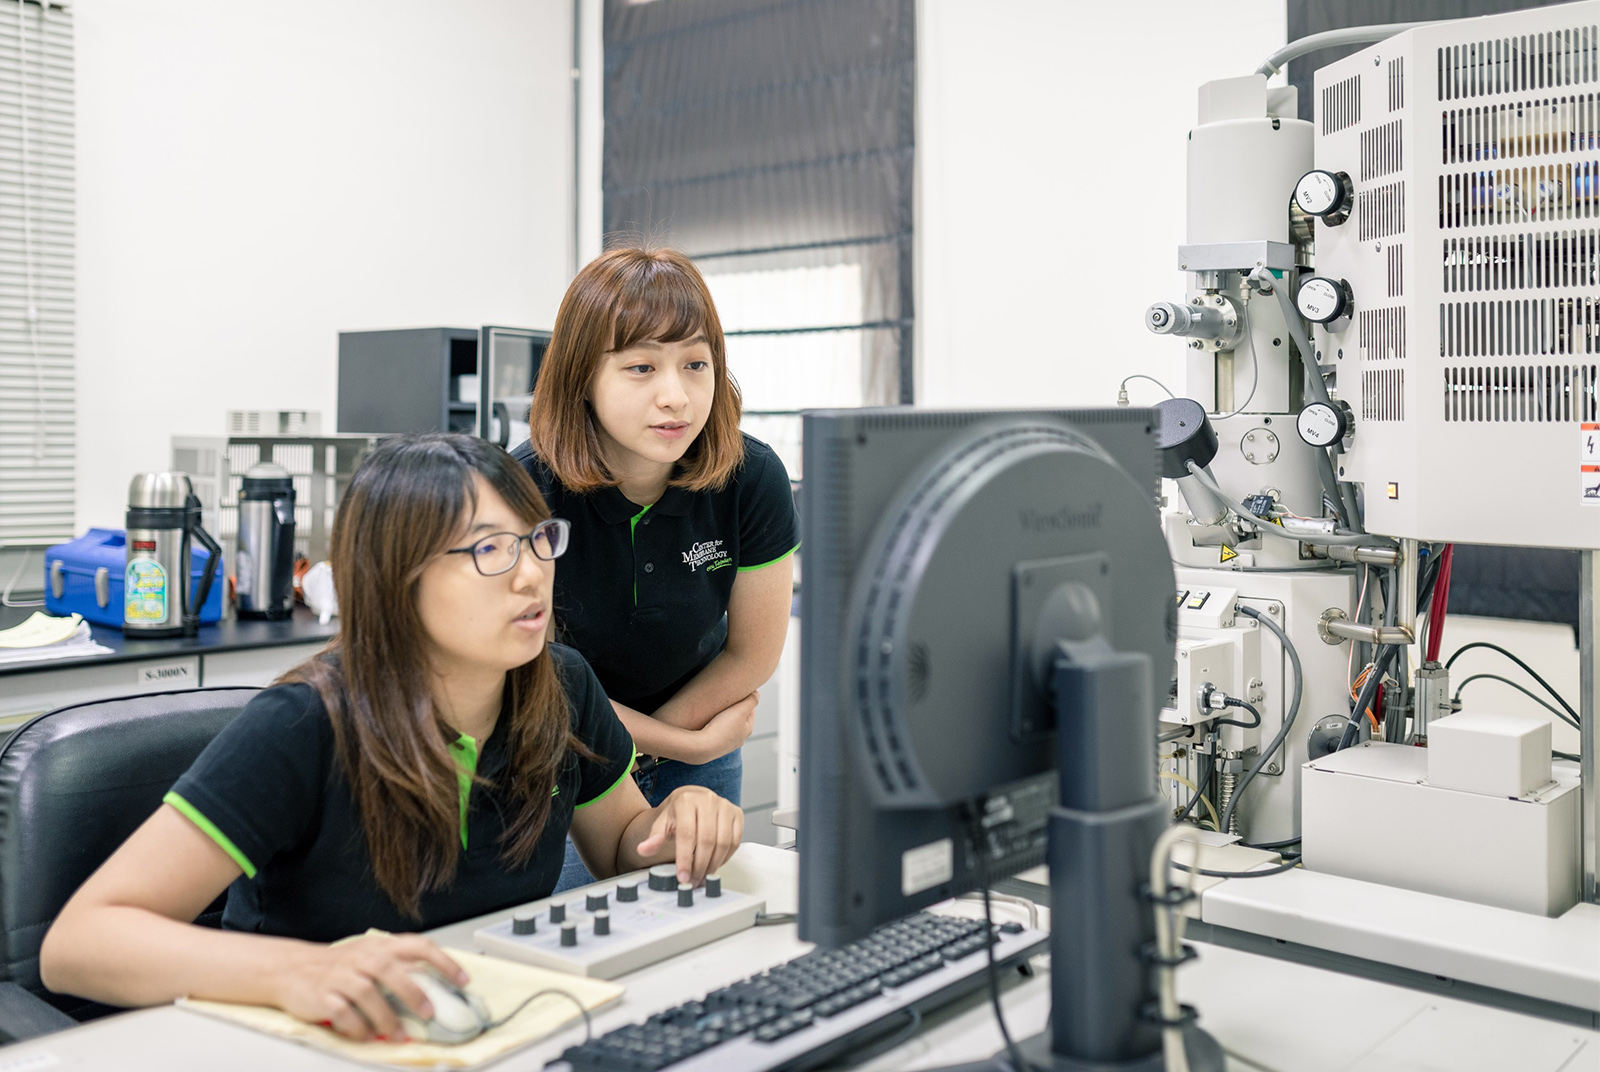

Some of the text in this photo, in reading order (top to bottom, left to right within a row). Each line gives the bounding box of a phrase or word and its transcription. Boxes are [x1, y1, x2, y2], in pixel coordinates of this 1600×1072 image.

[1302, 190, 1313, 204] MV2
[1323, 291, 1335, 300] CLOSE
[1306, 303, 1320, 314] MV3
[1307, 408, 1318, 416] OPEN
[1323, 417, 1336, 426] CLOSE
[1306, 427, 1320, 438] MV4
[144, 665, 189, 681] S-3000N
